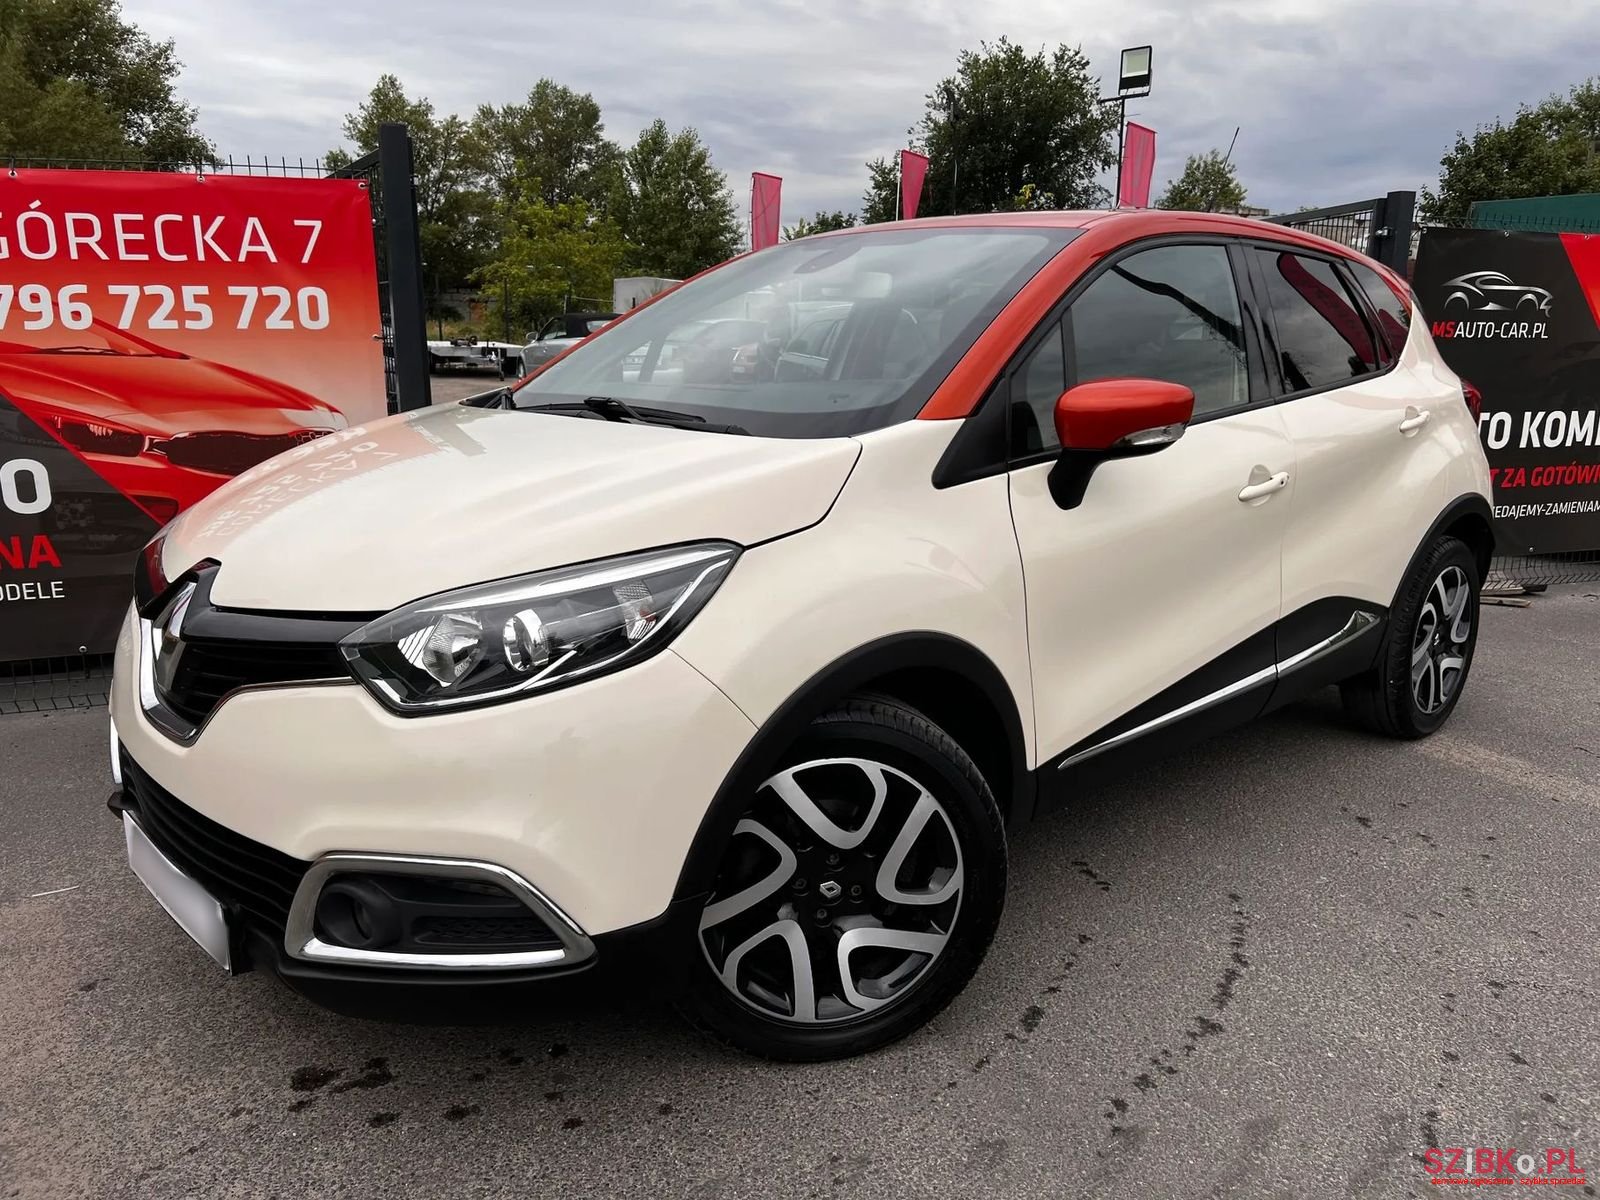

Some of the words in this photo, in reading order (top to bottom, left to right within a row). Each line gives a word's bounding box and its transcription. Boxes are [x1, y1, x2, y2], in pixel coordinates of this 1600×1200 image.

[0, 199, 278, 263] ÓRECKA
[293, 219, 322, 264] 7
[107, 285, 214, 330] 725
[228, 286, 330, 330] 720
[1432, 321, 1549, 339] MSAUTO-CAR.PL
[1519, 410, 1600, 449] KOM
[1501, 467, 1526, 488] ZA
[1492, 500, 1600, 520] EDAJEMY-ZAMIENIAM
[0, 581, 66, 601] DELE
